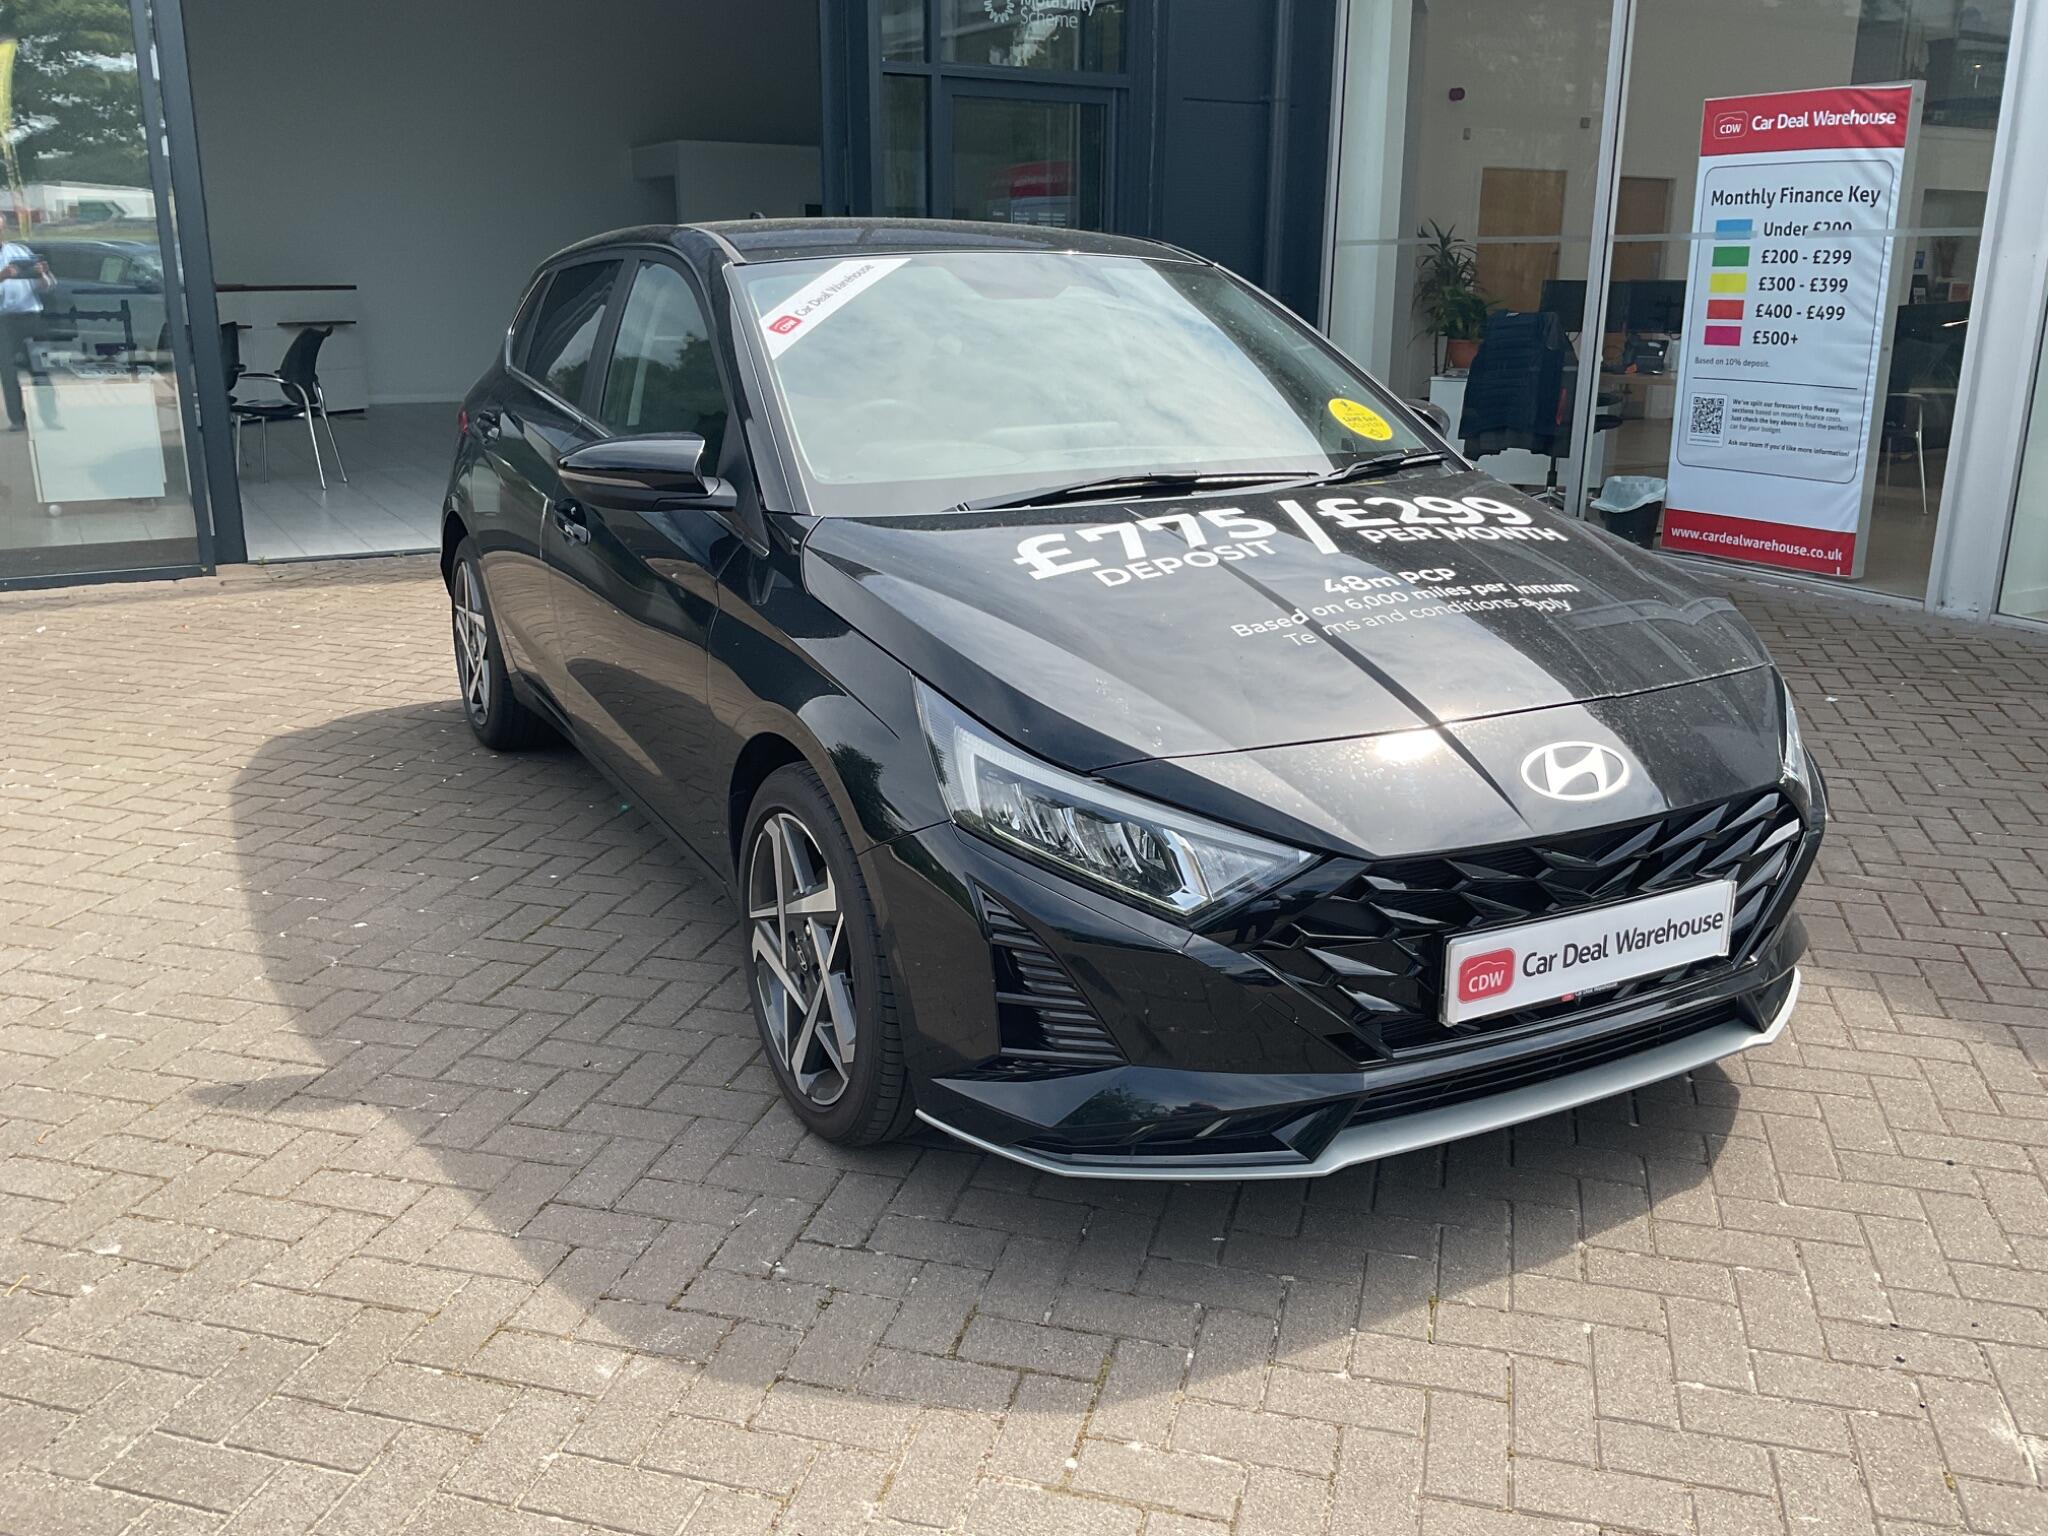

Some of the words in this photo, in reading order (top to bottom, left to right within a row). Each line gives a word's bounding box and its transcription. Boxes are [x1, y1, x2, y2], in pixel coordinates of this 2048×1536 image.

[1020, 6, 1079, 28] Scheme
[1720, 123, 1741, 134] CDW
[1752, 116, 1775, 131] Car
[1777, 111, 1809, 129] Deal
[1813, 109, 1896, 127] Warehouse
[1711, 187, 1776, 208] Monthly
[1780, 186, 1844, 204] Finance
[1848, 186, 1881, 208] Key
[1764, 222, 1808, 236] Under
[1761, 249, 1799, 264] £200
[1812, 250, 1852, 265] £299
[1758, 276, 1796, 292] £300
[1810, 277, 1848, 292] £399
[794, 305, 812, 316] Car
[1755, 304, 1792, 318] £400
[1806, 305, 1846, 321] £499
[1752, 330, 1798, 346] £500+
[1694, 356, 1714, 365] Based
[1726, 358, 1742, 366] 10%
[1743, 360, 1770, 368] deposit.
[1774, 402, 1800, 410] forecourt
[1814, 404, 1824, 412] five
[1770, 418, 1779, 426] key
[1316, 496, 1534, 528] £299
[1012, 507, 1278, 581] £775
[1356, 526, 1443, 544] PER
[1437, 526, 1569, 542] MONTH
[1671, 527, 1843, 561] www.cardealwarehouse.co.uk
[1092, 539, 1277, 587] DEPOSIT
[1324, 574, 1401, 594] 48m
[1398, 568, 1457, 584] PCP
[1230, 608, 1310, 638] Based
[1311, 604, 1345, 616] on
[1344, 591, 1409, 610] 6,000
[1411, 584, 1472, 600] miles
[1471, 582, 1508, 596] per
[1362, 609, 1408, 627] and
[1410, 597, 1520, 618] conditions
[1522, 951, 1558, 978] Car
[1562, 934, 1610, 969] Deal
[1615, 911, 1724, 954] Warehouse
[1468, 970, 1505, 993] CDW
